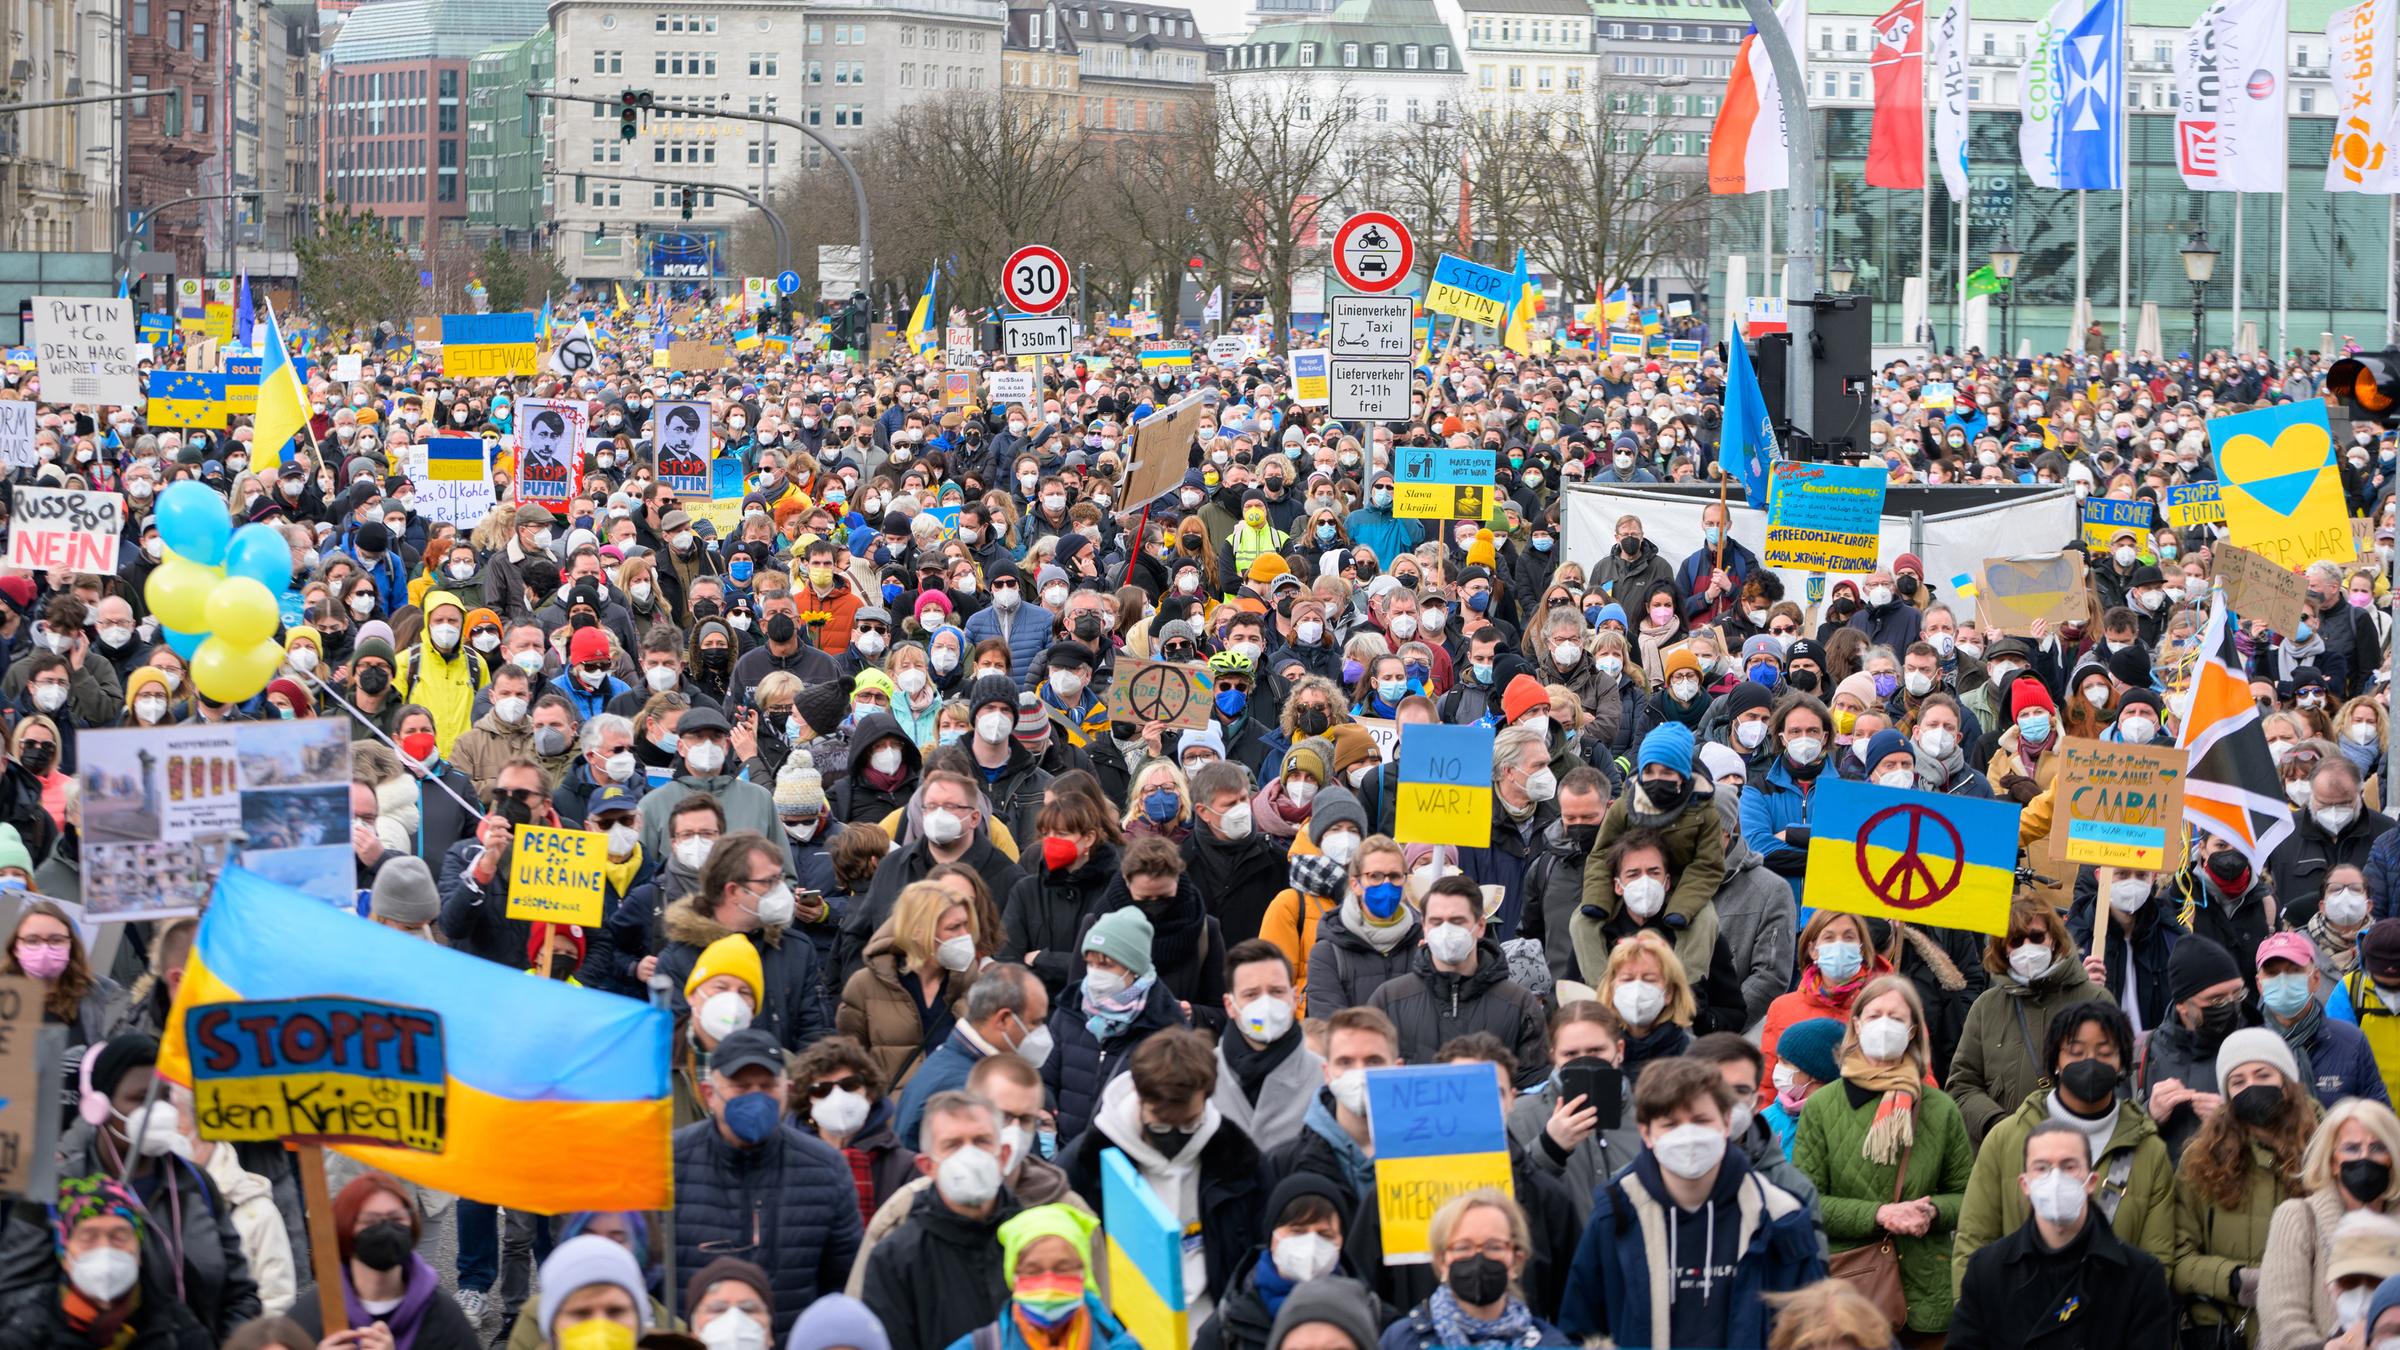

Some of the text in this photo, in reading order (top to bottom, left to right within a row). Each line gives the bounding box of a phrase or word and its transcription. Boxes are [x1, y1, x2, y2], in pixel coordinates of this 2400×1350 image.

[663, 264, 708, 276] NVEA
[1017, 265, 1055, 295] 30
[1449, 267, 1501, 294] STOP
[1438, 286, 1494, 314] PUTIN
[50, 301, 119, 324] PUTIN
[1338, 304, 1407, 317] Linienverkehr
[1366, 320, 1393, 332] Taxi
[1022, 332, 1056, 347] 350m
[1380, 337, 1403, 348] frei
[41, 343, 127, 361] DEN HAAG
[231, 365, 262, 375] SOLID
[1337, 368, 1404, 380] Lieferverkehr
[1359, 401, 1382, 412] frei
[524, 466, 567, 480] STOP
[660, 461, 706, 475] STOP
[523, 481, 567, 496] PUTIN
[1405, 490, 1432, 498] Slawa
[1400, 503, 1437, 513] Ukrajini
[2183, 503, 2225, 522] PUTIN
[2298, 527, 2344, 559] WAR
[2067, 749, 2115, 768] Freiheit
[1429, 756, 1462, 781] NO
[2075, 822, 2097, 832] STOP
[523, 832, 586, 857] PEACE
[547, 853, 568, 866] for
[519, 865, 602, 892] UKRAINE
[198, 1009, 433, 1075] STOPPT
[1392, 1078, 1466, 1109] NEIN
[202, 1087, 273, 1130] den
[1403, 1116, 1457, 1142] ZU
